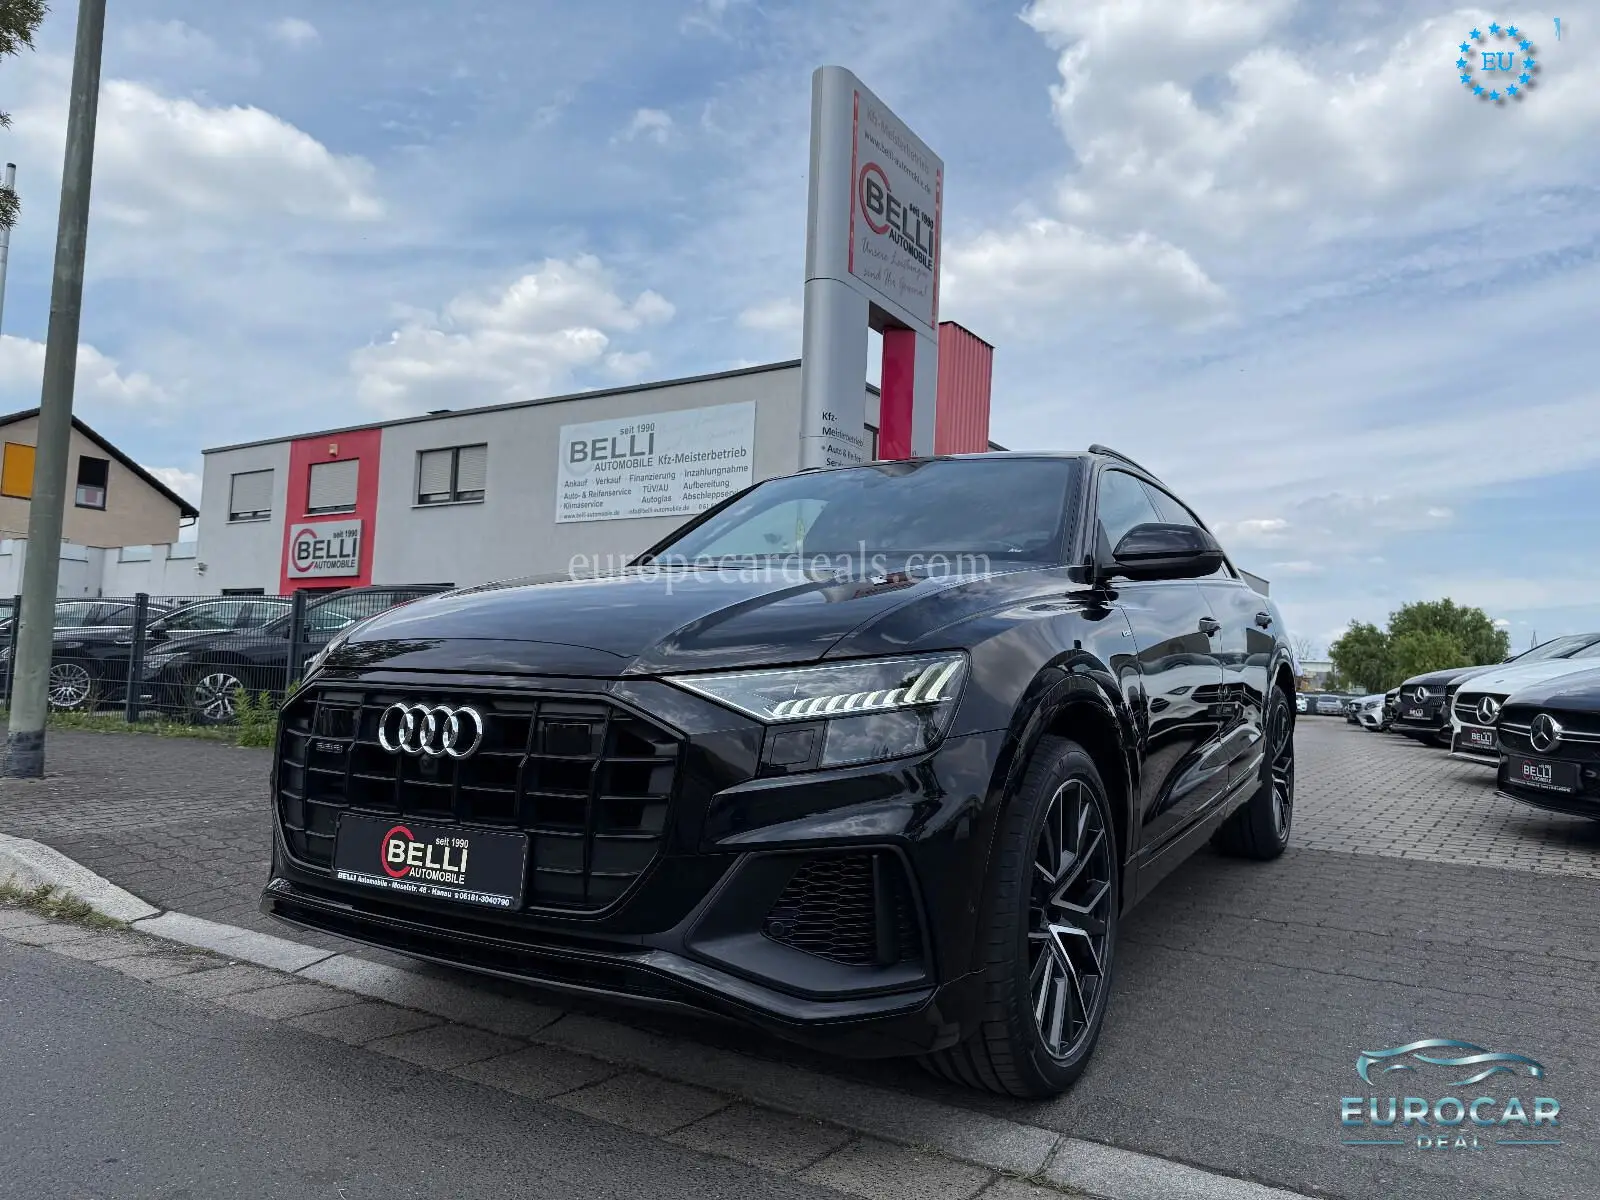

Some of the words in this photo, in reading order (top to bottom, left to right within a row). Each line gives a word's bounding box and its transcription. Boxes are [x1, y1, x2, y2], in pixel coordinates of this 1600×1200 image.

[866, 177, 933, 257] BELLI
[889, 229, 933, 272] AUTOMOBILE
[822, 411, 838, 421] Kfz-
[620, 426, 634, 435] seit
[637, 423, 655, 433] 1990
[570, 432, 655, 463] BELLI
[658, 446, 747, 465] Kfz-Meisterbetrieb
[594, 457, 653, 472] AUTOMOBILE
[564, 478, 588, 488] Ankauf
[595, 475, 621, 485] Verkauf
[629, 471, 676, 482] Finanzierung
[684, 464, 749, 478] Inzahlungnahme
[588, 488, 632, 498] Reifenservice
[683, 479, 730, 490] Aufbereitung
[563, 501, 604, 510] Klimaservice
[641, 495, 672, 504] Autoglas
[297, 538, 357, 561] BELLI
[313, 560, 356, 570] AUTOMOBILE
[1523, 764, 1552, 779] BELLI
[435, 837, 449, 846] seit
[452, 838, 469, 848] 1990
[387, 839, 468, 872] BELLI
[337, 871, 357, 882] BELLI
[409, 867, 465, 884] AUTOMOBILE
